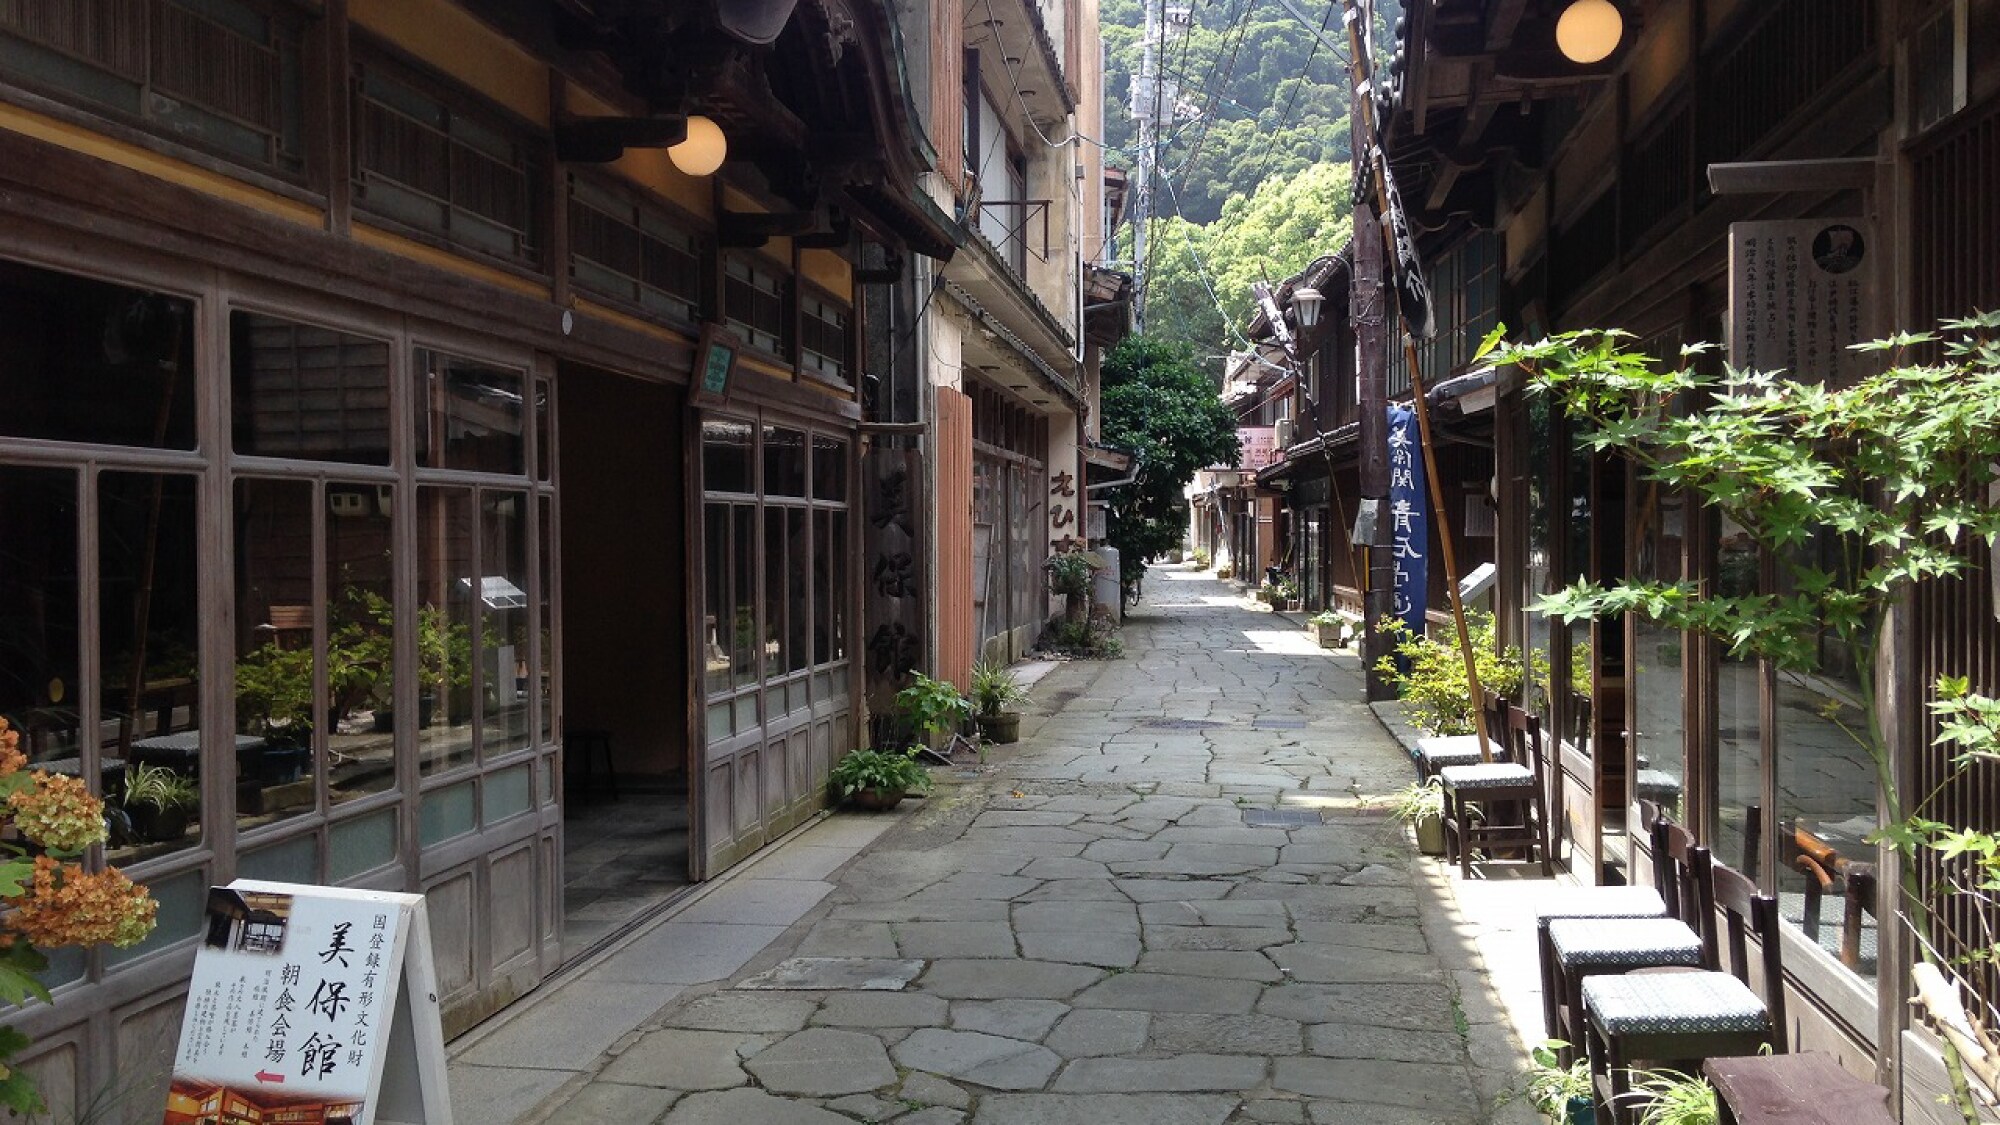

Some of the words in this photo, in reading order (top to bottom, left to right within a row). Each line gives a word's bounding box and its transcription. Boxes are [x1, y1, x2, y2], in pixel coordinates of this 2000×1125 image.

[264, 962, 300, 1063] 朝食会場
[297, 921, 355, 1081] 美保館
[347, 913, 387, 1068] 国登録有形文化財
